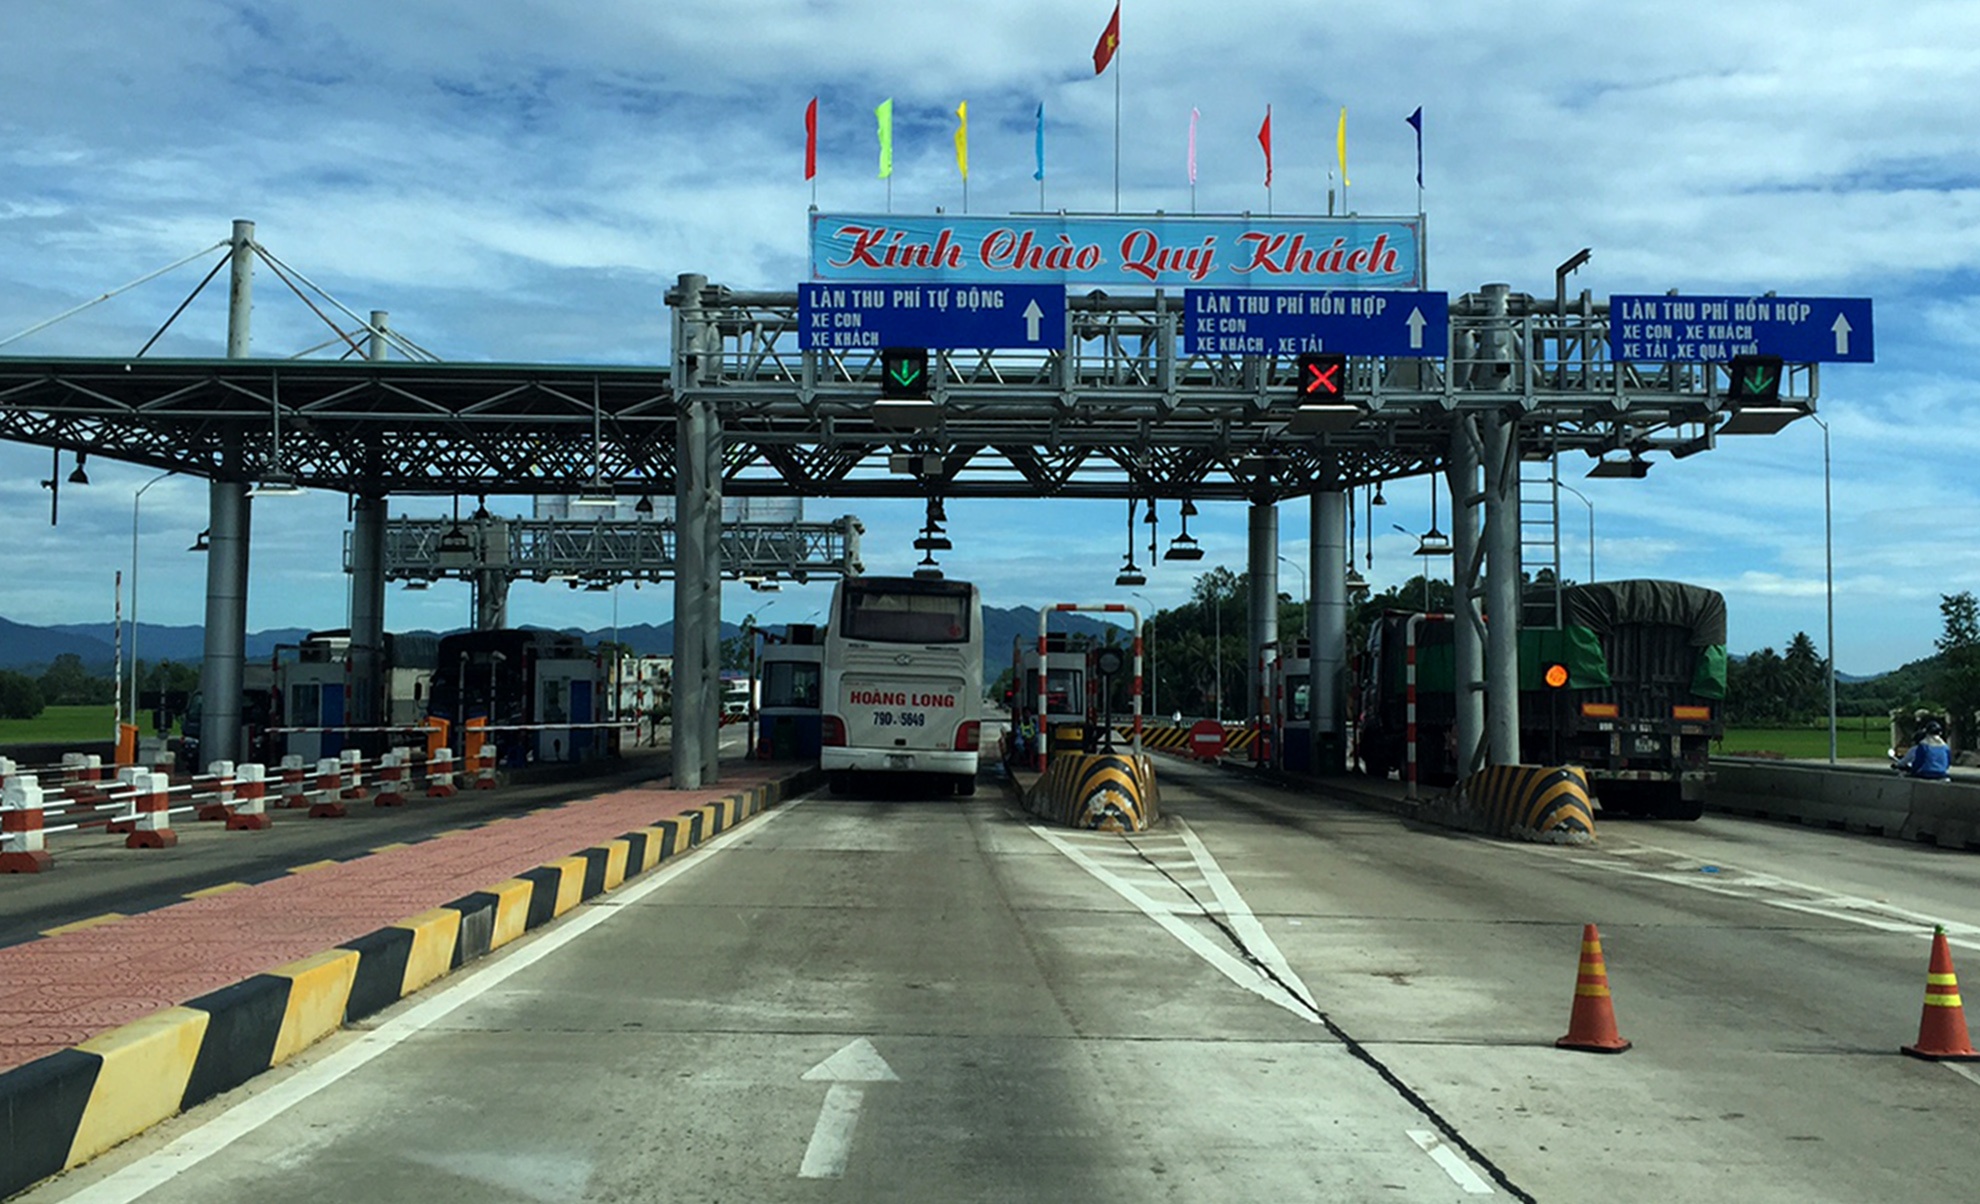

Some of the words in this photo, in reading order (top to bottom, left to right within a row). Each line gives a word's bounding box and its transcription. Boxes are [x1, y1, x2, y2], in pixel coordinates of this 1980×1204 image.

[828, 226, 965, 269] Kính
[980, 228, 1103, 270] Chào
[1120, 229, 1217, 281] Quý
[1230, 230, 1401, 274] Khách
[810, 286, 845, 308] LÀN
[852, 290, 884, 308] THU
[893, 286, 921, 308] PHÍ
[927, 287, 950, 312] TỰ
[956, 286, 1004, 312] ĐỘNG
[1197, 292, 1231, 314] LÀN
[1237, 296, 1269, 314] THU
[1277, 293, 1303, 315] PHÍ
[1351, 295, 1387, 319] HỢP
[811, 313, 829, 327] XE
[834, 313, 861, 327] CON
[1622, 299, 1656, 320] LÀN
[1663, 302, 1695, 320] THU
[1701, 300, 1728, 321] PHÍ
[1775, 301, 1811, 325] HỢP
[1197, 318, 1215, 332] XE
[1219, 318, 1246, 332] CON
[1623, 325, 1641, 339] XE
[1686, 325, 1703, 340] XE
[1708, 322, 1753, 340] KHÁCH
[811, 332, 829, 346] XE
[834, 329, 879, 346] KHÁCH
[1197, 337, 1215, 352] XE
[1279, 338, 1296, 352] XE
[1301, 334, 1323, 352] TẢI
[1623, 343, 1641, 358] XE
[1677, 344, 1695, 358] XE
[1699, 342, 1727, 359] QUÁ
[850, 688, 906, 706] HOÀNG
[911, 693, 955, 707] LONG
